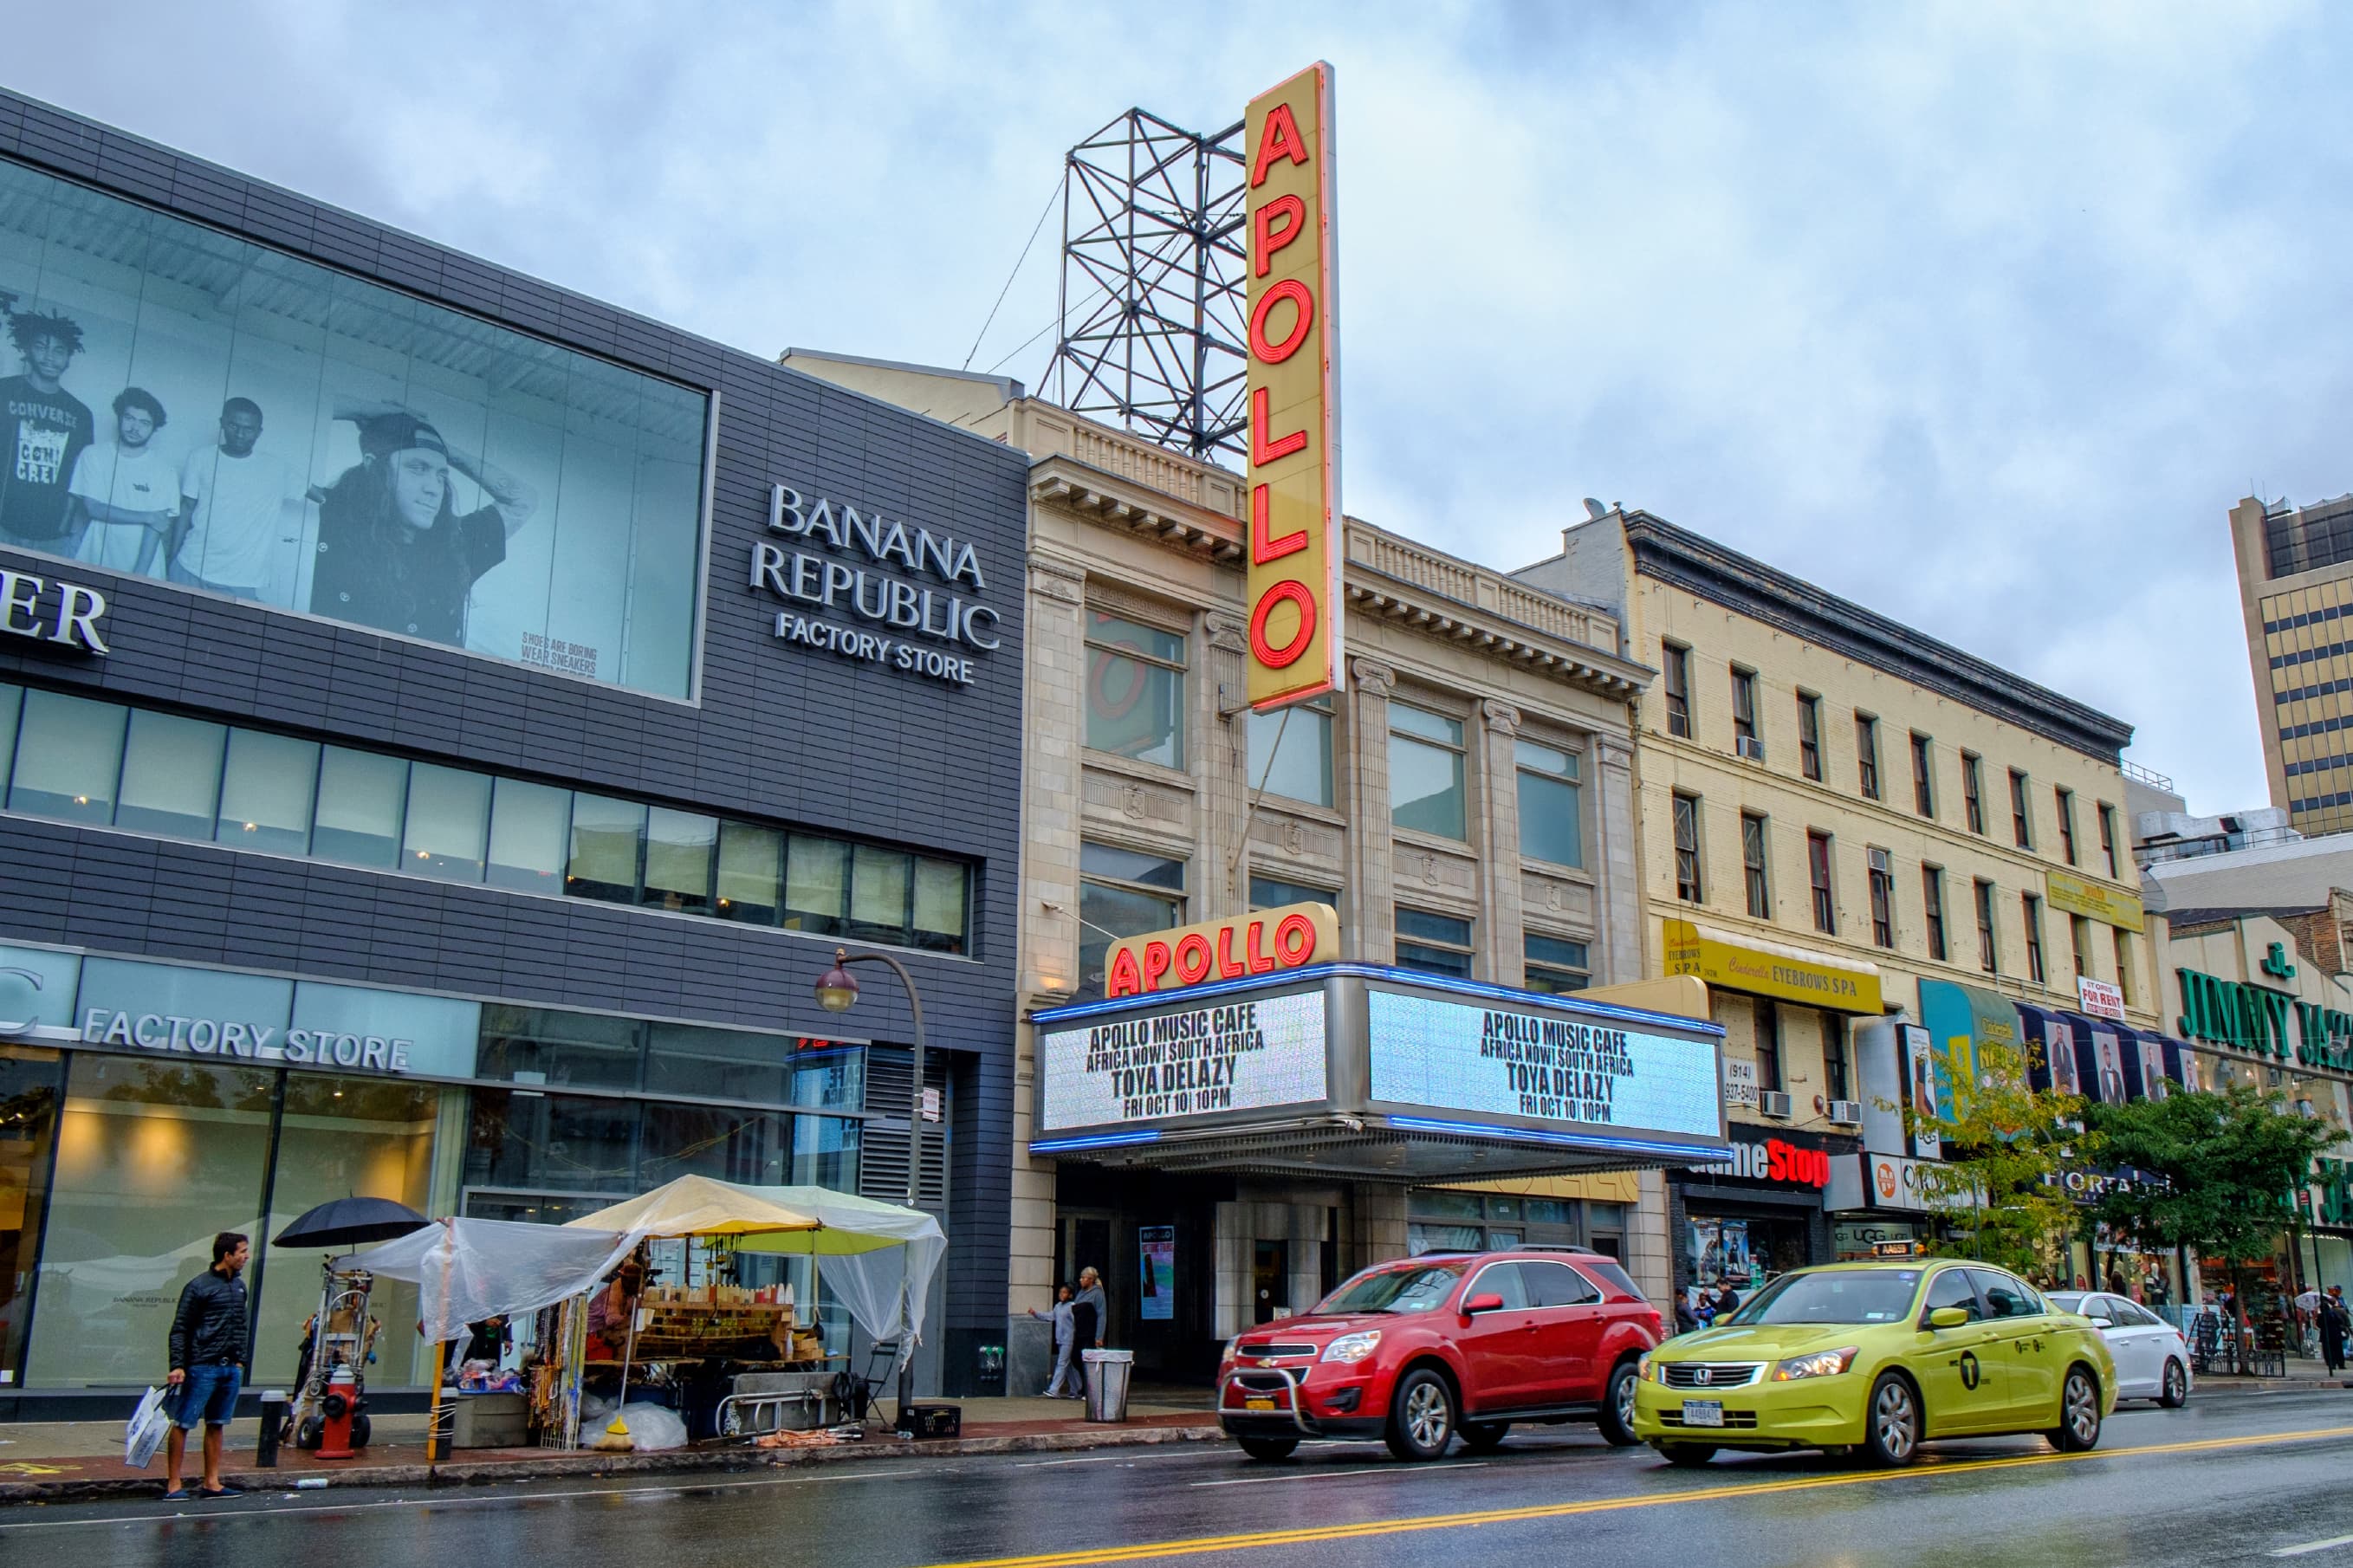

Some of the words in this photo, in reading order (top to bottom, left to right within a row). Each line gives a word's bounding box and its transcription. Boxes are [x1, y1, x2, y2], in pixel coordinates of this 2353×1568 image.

[1249, 103, 1317, 669] APOLLO
[769, 483, 986, 590] BANANA
[749, 541, 1000, 650] REPUBLIC
[522, 632, 549, 649] SHOES
[551, 639, 567, 652] ARE
[568, 643, 597, 660] BORING
[522, 645, 549, 664] WEAR
[551, 652, 596, 674] SNEAKERS
[775, 612, 891, 663] FACTORY
[896, 645, 975, 684] STORE
[1110, 914, 1316, 997] APOLLO
[1675, 962, 1701, 974] SPA
[1773, 965, 1829, 992] EYEBROWS
[1832, 978, 1857, 996] SPA
[2082, 988, 2098, 1003] FOR
[2099, 993, 2121, 1008] RENT
[1090, 1020, 1148, 1053] APOLLO
[1153, 1011, 1208, 1044] MUSIC
[1213, 1003, 1255, 1033] CAFE
[1483, 1011, 1539, 1044] APOLLO
[1542, 1020, 1589, 1051] MUSIC
[1592, 1028, 1627, 1056] CAFE
[2175, 968, 2292, 1059] JIMMY
[82, 1007, 275, 1058] FACTORY
[283, 1028, 414, 1072] STORE
[1086, 1049, 1130, 1072] AFRICA
[1132, 1046, 1166, 1066] NOW!
[1170, 1037, 1211, 1060] SOUTH
[1215, 1030, 1263, 1053] AFRICA
[1481, 1038, 1522, 1062] AFRICA
[1525, 1044, 1555, 1066] NOW!
[1559, 1048, 1593, 1072] SOUTH
[1596, 1054, 1634, 1077] AFRICA
[1112, 1064, 1157, 1098] TOYA
[1163, 1055, 1236, 1092] DELAZY
[1506, 1062, 1550, 1095] TOYA
[1552, 1068, 1613, 1103] DELAZY
[1729, 1064, 1751, 1079] (914)
[1124, 1096, 1142, 1118] FRI
[1146, 1094, 1170, 1115] OCT
[1196, 1087, 1230, 1110] 10PM
[1519, 1093, 1537, 1114] FRI
[1539, 1096, 1561, 1118] OCT
[1582, 1103, 1611, 1122] 10PM
[1726, 1083, 1758, 1102] 937-5400
[1689, 1138, 1830, 1188] meStop
[1853, 1228, 1886, 1244] UGG
